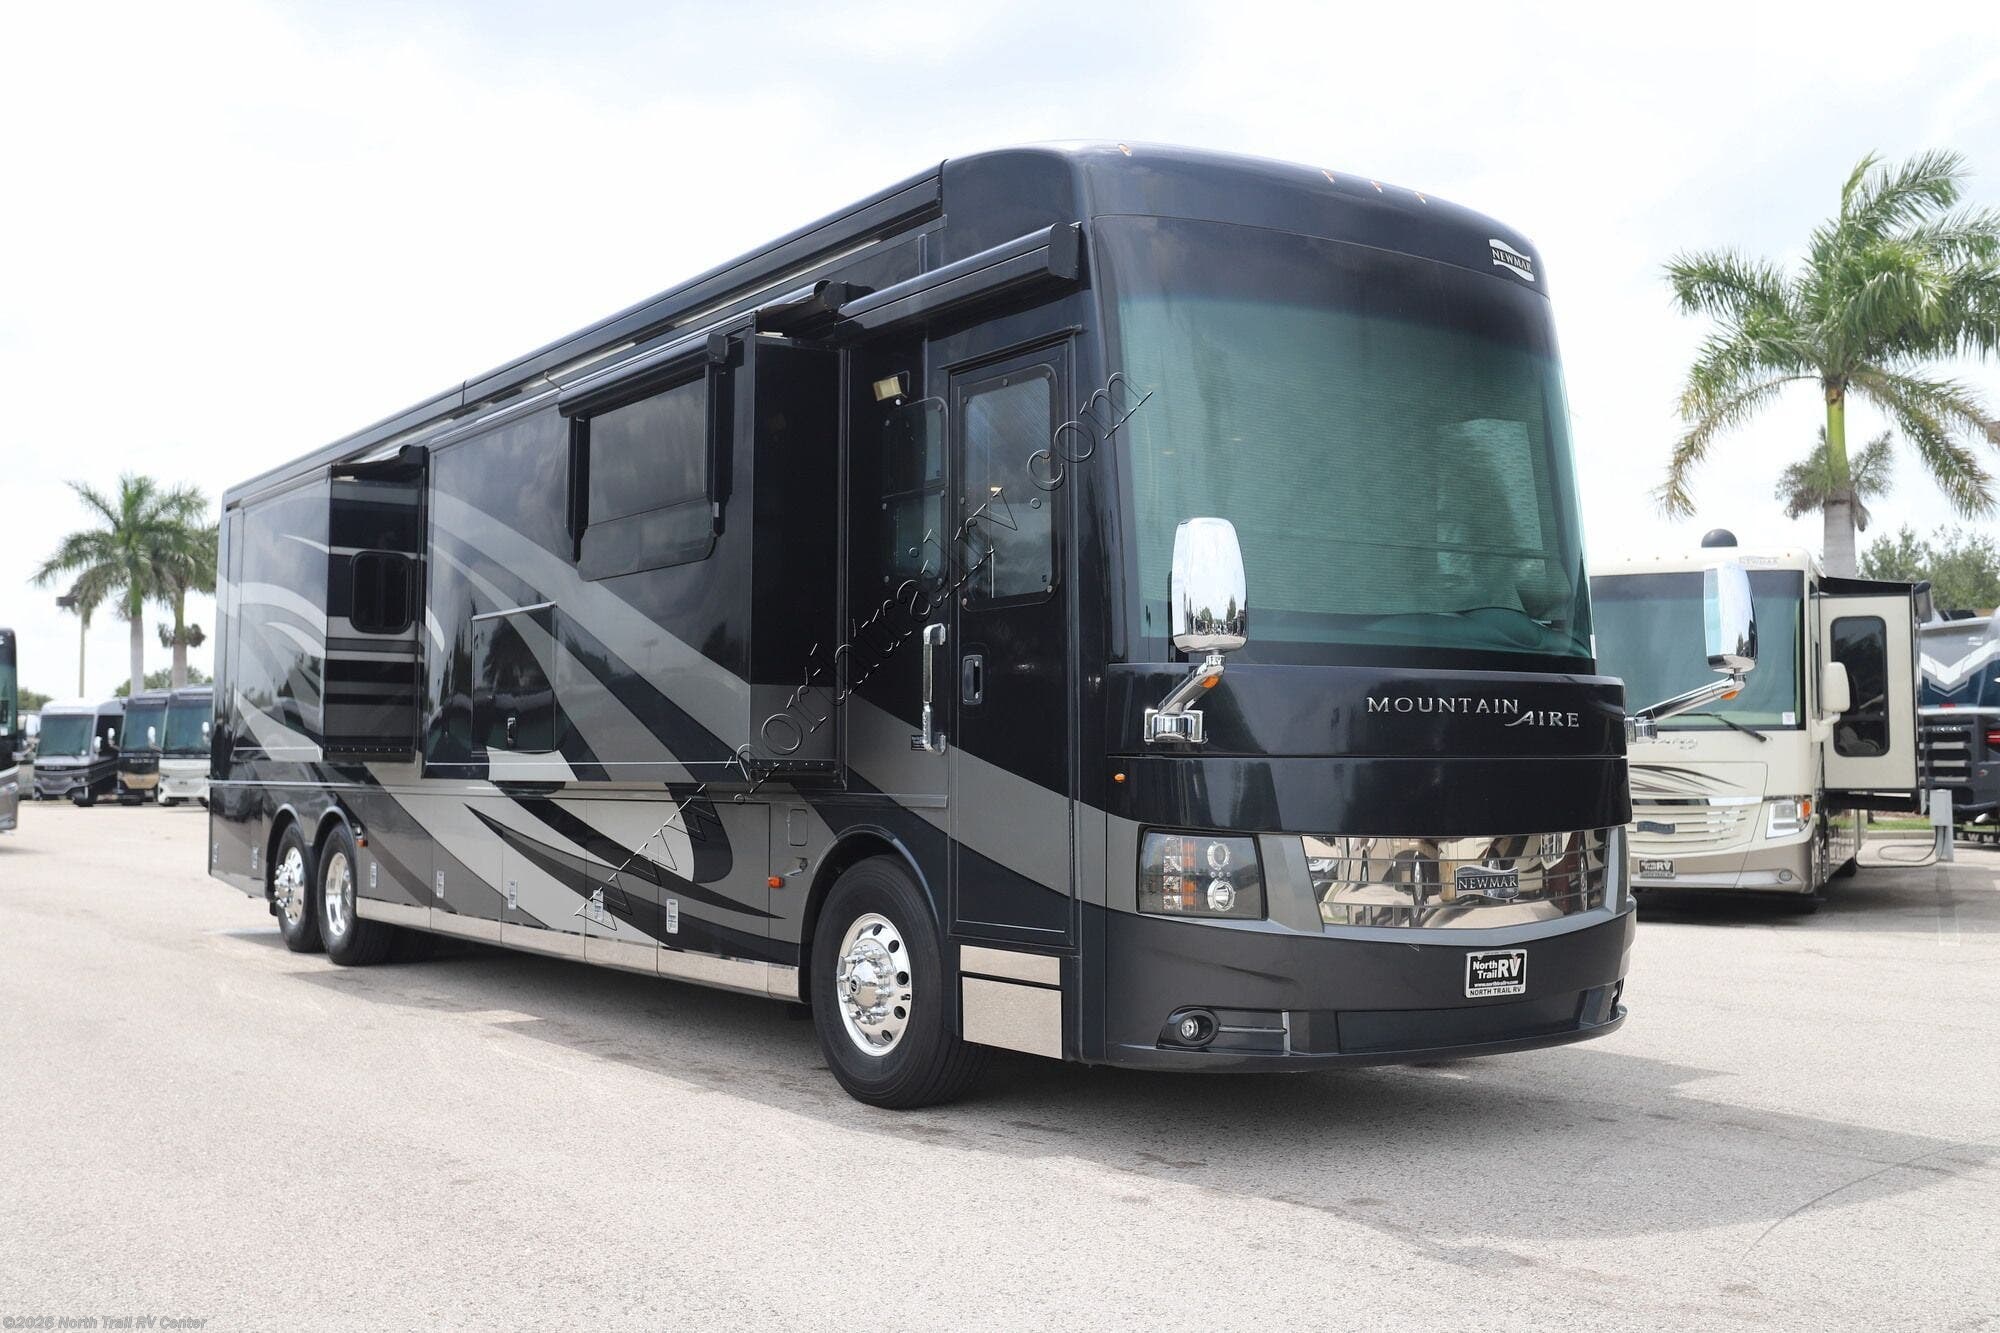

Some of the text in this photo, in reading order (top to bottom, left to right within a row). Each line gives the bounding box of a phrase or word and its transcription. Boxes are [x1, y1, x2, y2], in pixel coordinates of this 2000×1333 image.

[1492, 249, 1532, 272] NEWMAR
[1367, 697, 1580, 728] MOUNTAIN AIRE
[1458, 876, 1517, 889] NEWMAR
[1472, 958, 1522, 978] North RV
[1477, 969, 1498, 979] Trail
[1469, 988, 1492, 997] NORTH
[1493, 987, 1512, 995] TRAIL
